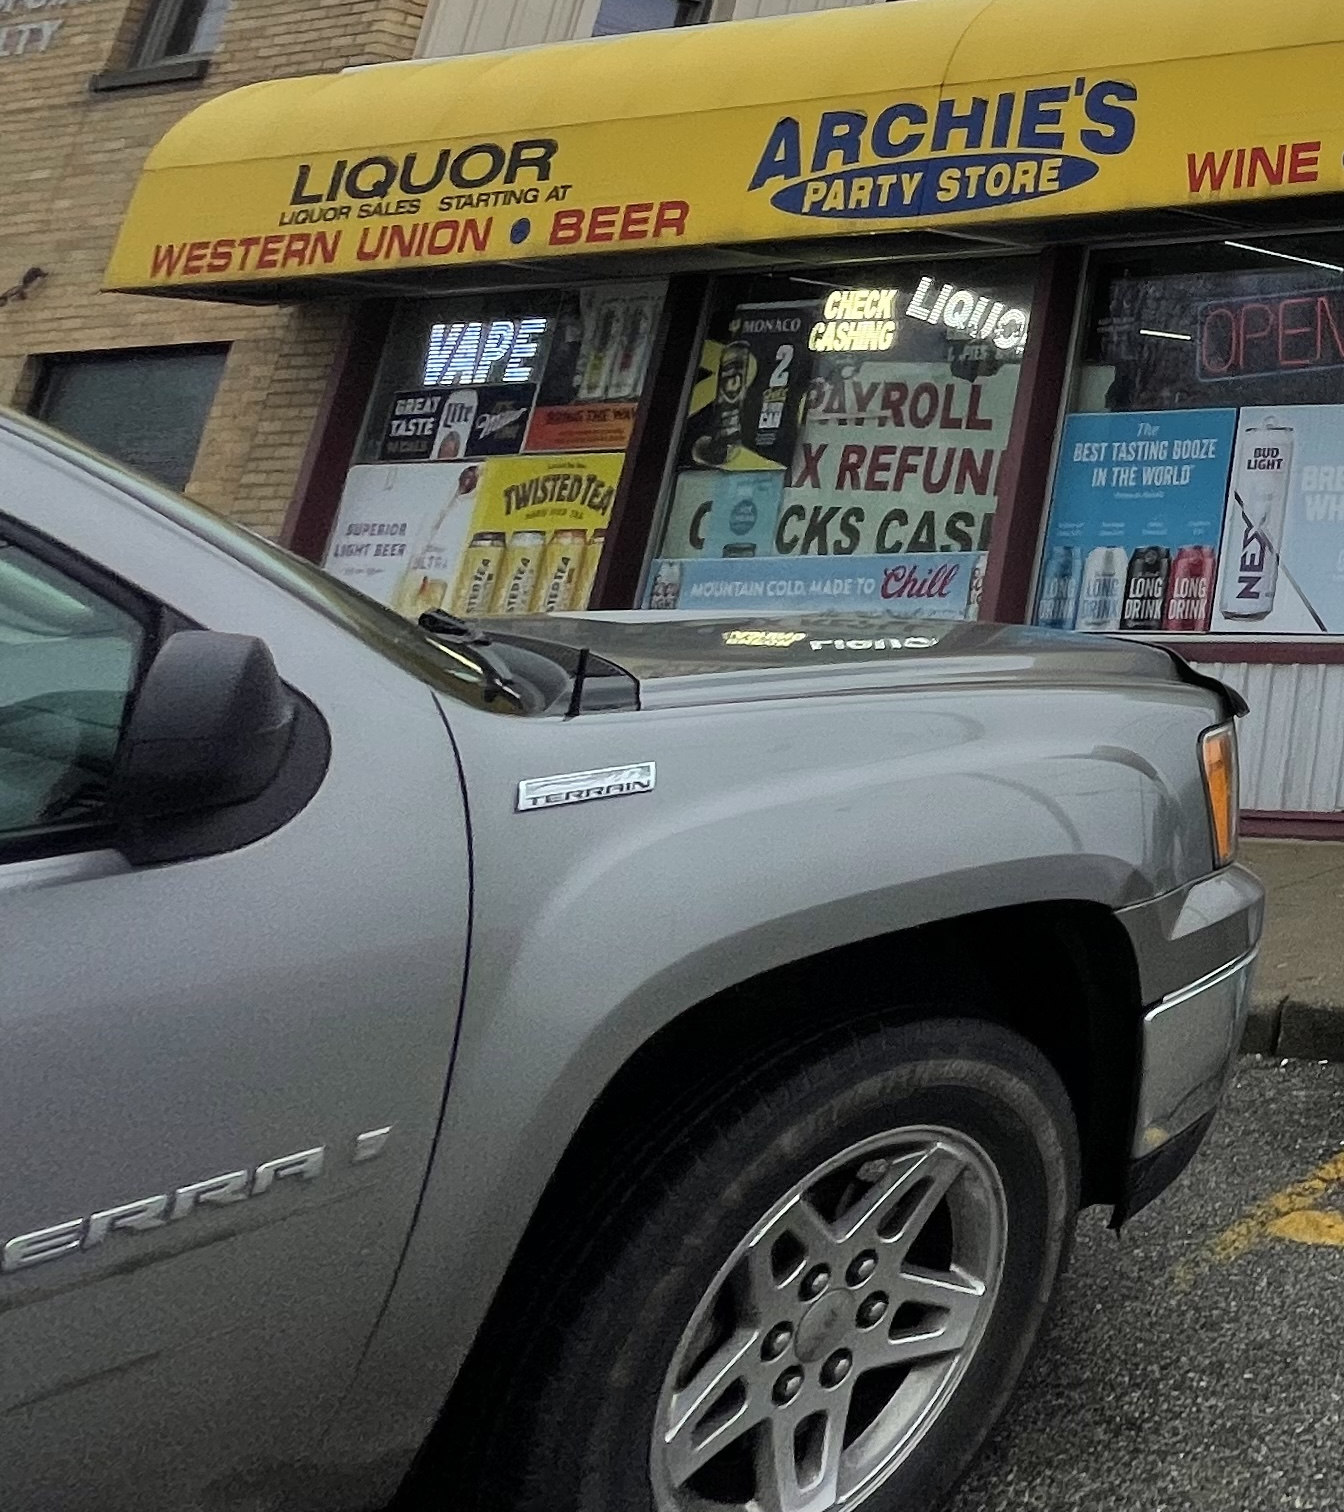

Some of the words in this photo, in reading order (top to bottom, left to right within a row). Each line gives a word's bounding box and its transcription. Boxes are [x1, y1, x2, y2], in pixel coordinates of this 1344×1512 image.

[747, 75, 1139, 192] ARCHIE'S
[289, 138, 559, 207] LIQUOR
[1186, 139, 1322, 195] WINE
[801, 171, 927, 215] PARTY
[936, 157, 1064, 204] STORE
[278, 207, 351, 228] LIQUOR
[356, 198, 422, 219] SALES
[437, 187, 540, 213] STARTING
[544, 184, 573, 203] AT
[150, 229, 343, 279] WESTERN
[355, 215, 495, 263] UNION
[547, 199, 691, 247] BEER
[823, 288, 898, 320] CHECK
[742, 317, 802, 334] MONACO
[807, 320, 896, 353] CASHING
[423, 317, 548, 387] VAPE
[769, 344, 794, 388] 2
[394, 395, 442, 416] GREAT
[806, 380, 993, 431] PAYROLL
[389, 416, 436, 438] TASTE
[1136, 422, 1161, 438] The
[1073, 441, 1108, 463] BEST
[1111, 440, 1169, 462] TASTING
[1171, 438, 1219, 461] BOOZE
[1253, 447, 1280, 459] BUD
[1091, 467, 1108, 488] IN
[1111, 466, 1136, 487] THE
[1142, 464, 1191, 486] WORLD
[1246, 458, 1284, 470] LIGHT
[503, 473, 583, 516] TWISTED
[580, 473, 616, 516] TEA
[345, 522, 408, 537] SUPERIOR
[689, 499, 866, 556] CCKS
[333, 542, 370, 558] LIGHT
[373, 542, 408, 557] BEER
[690, 580, 764, 598] MOUNTAIN
[809, 578, 854, 596] MADE
[856, 577, 876, 595] TO
[880, 563, 961, 600] Chill
[1085, 577, 1120, 598] LONG
[1128, 576, 1164, 598] LONG
[1172, 576, 1207, 598] LONG
[1123, 598, 1164, 620] DRINK
[1167, 598, 1207, 620] DRINK
[526, 779, 651, 806] TERRAIN
[3, 1145, 326, 1272] ERRA
